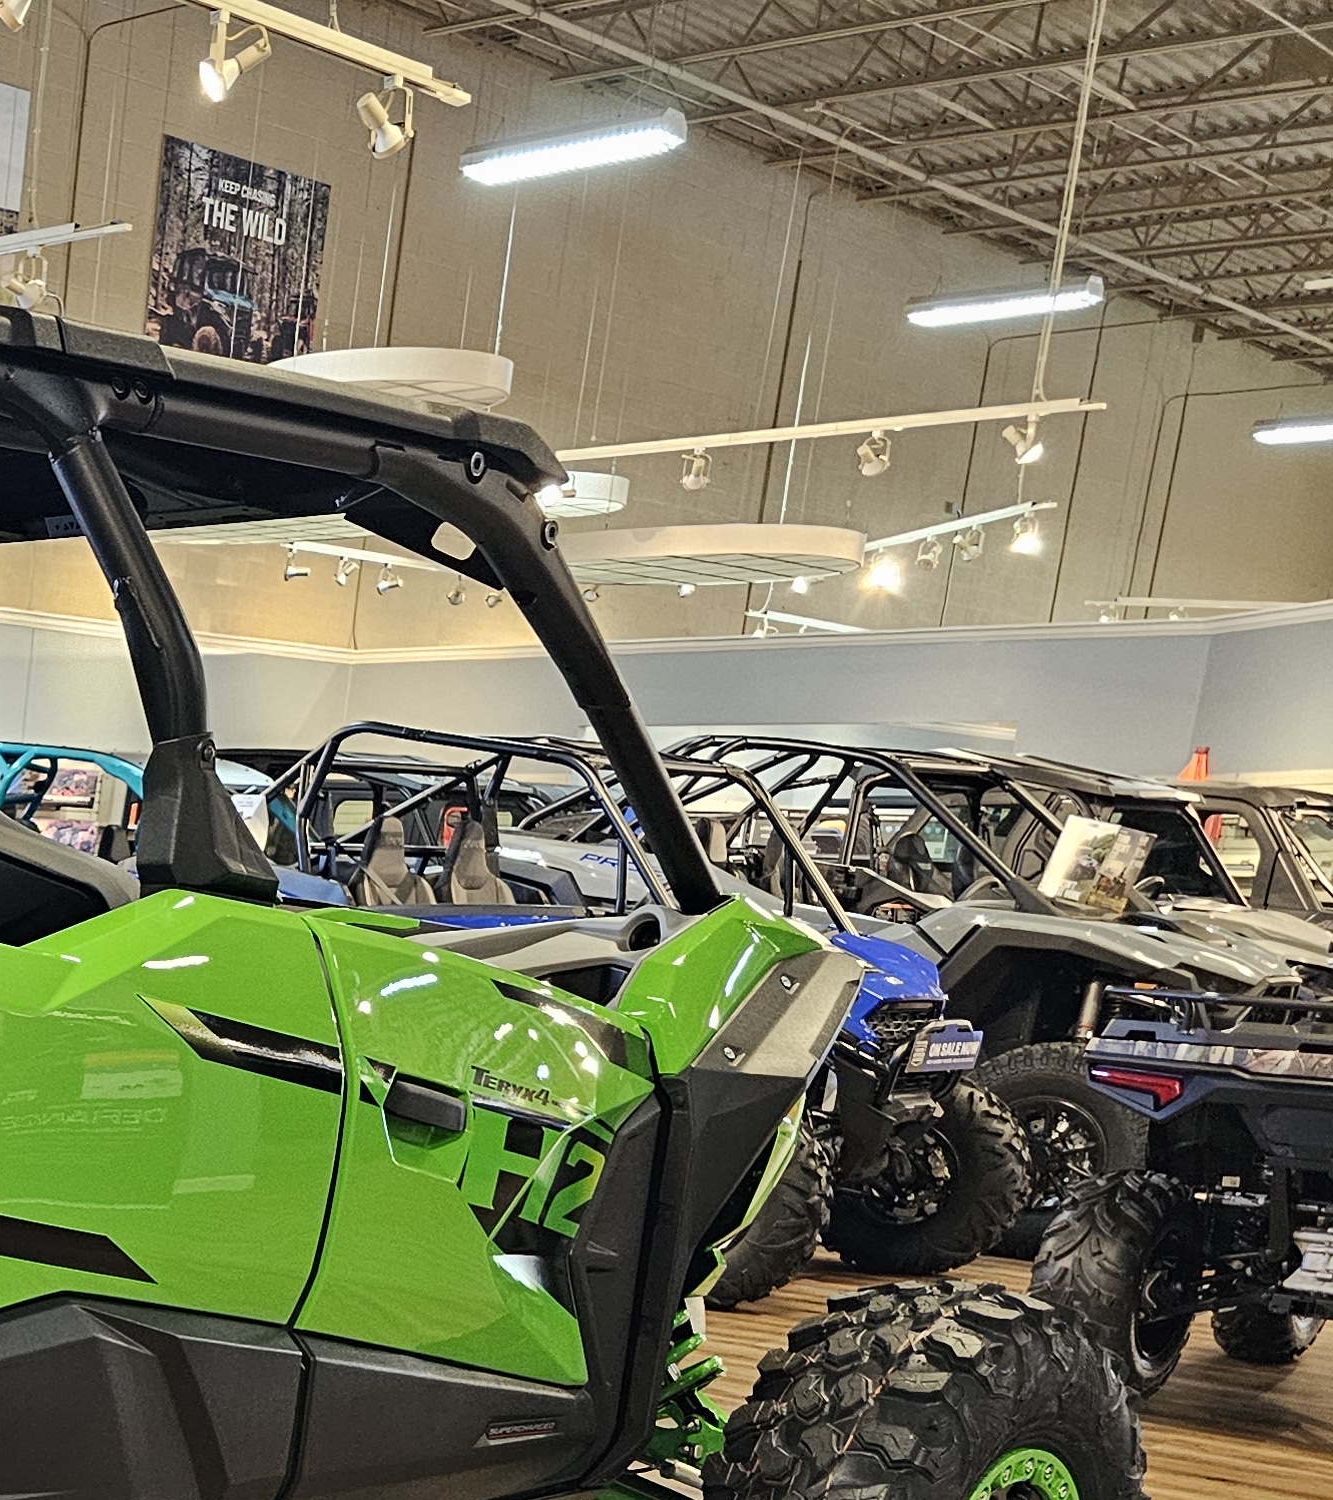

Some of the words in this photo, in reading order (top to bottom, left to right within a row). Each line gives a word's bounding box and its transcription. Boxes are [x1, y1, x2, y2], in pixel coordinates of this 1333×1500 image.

[218, 178, 241, 195] KEEP
[202, 196, 239, 233] THE
[242, 207, 287, 246] WILD
[928, 1042, 941, 1057] ON
[940, 1042, 961, 1056] SALE
[460, 1106, 606, 1239] H2
[489, 1422, 555, 1435] SUPERCHARGED
